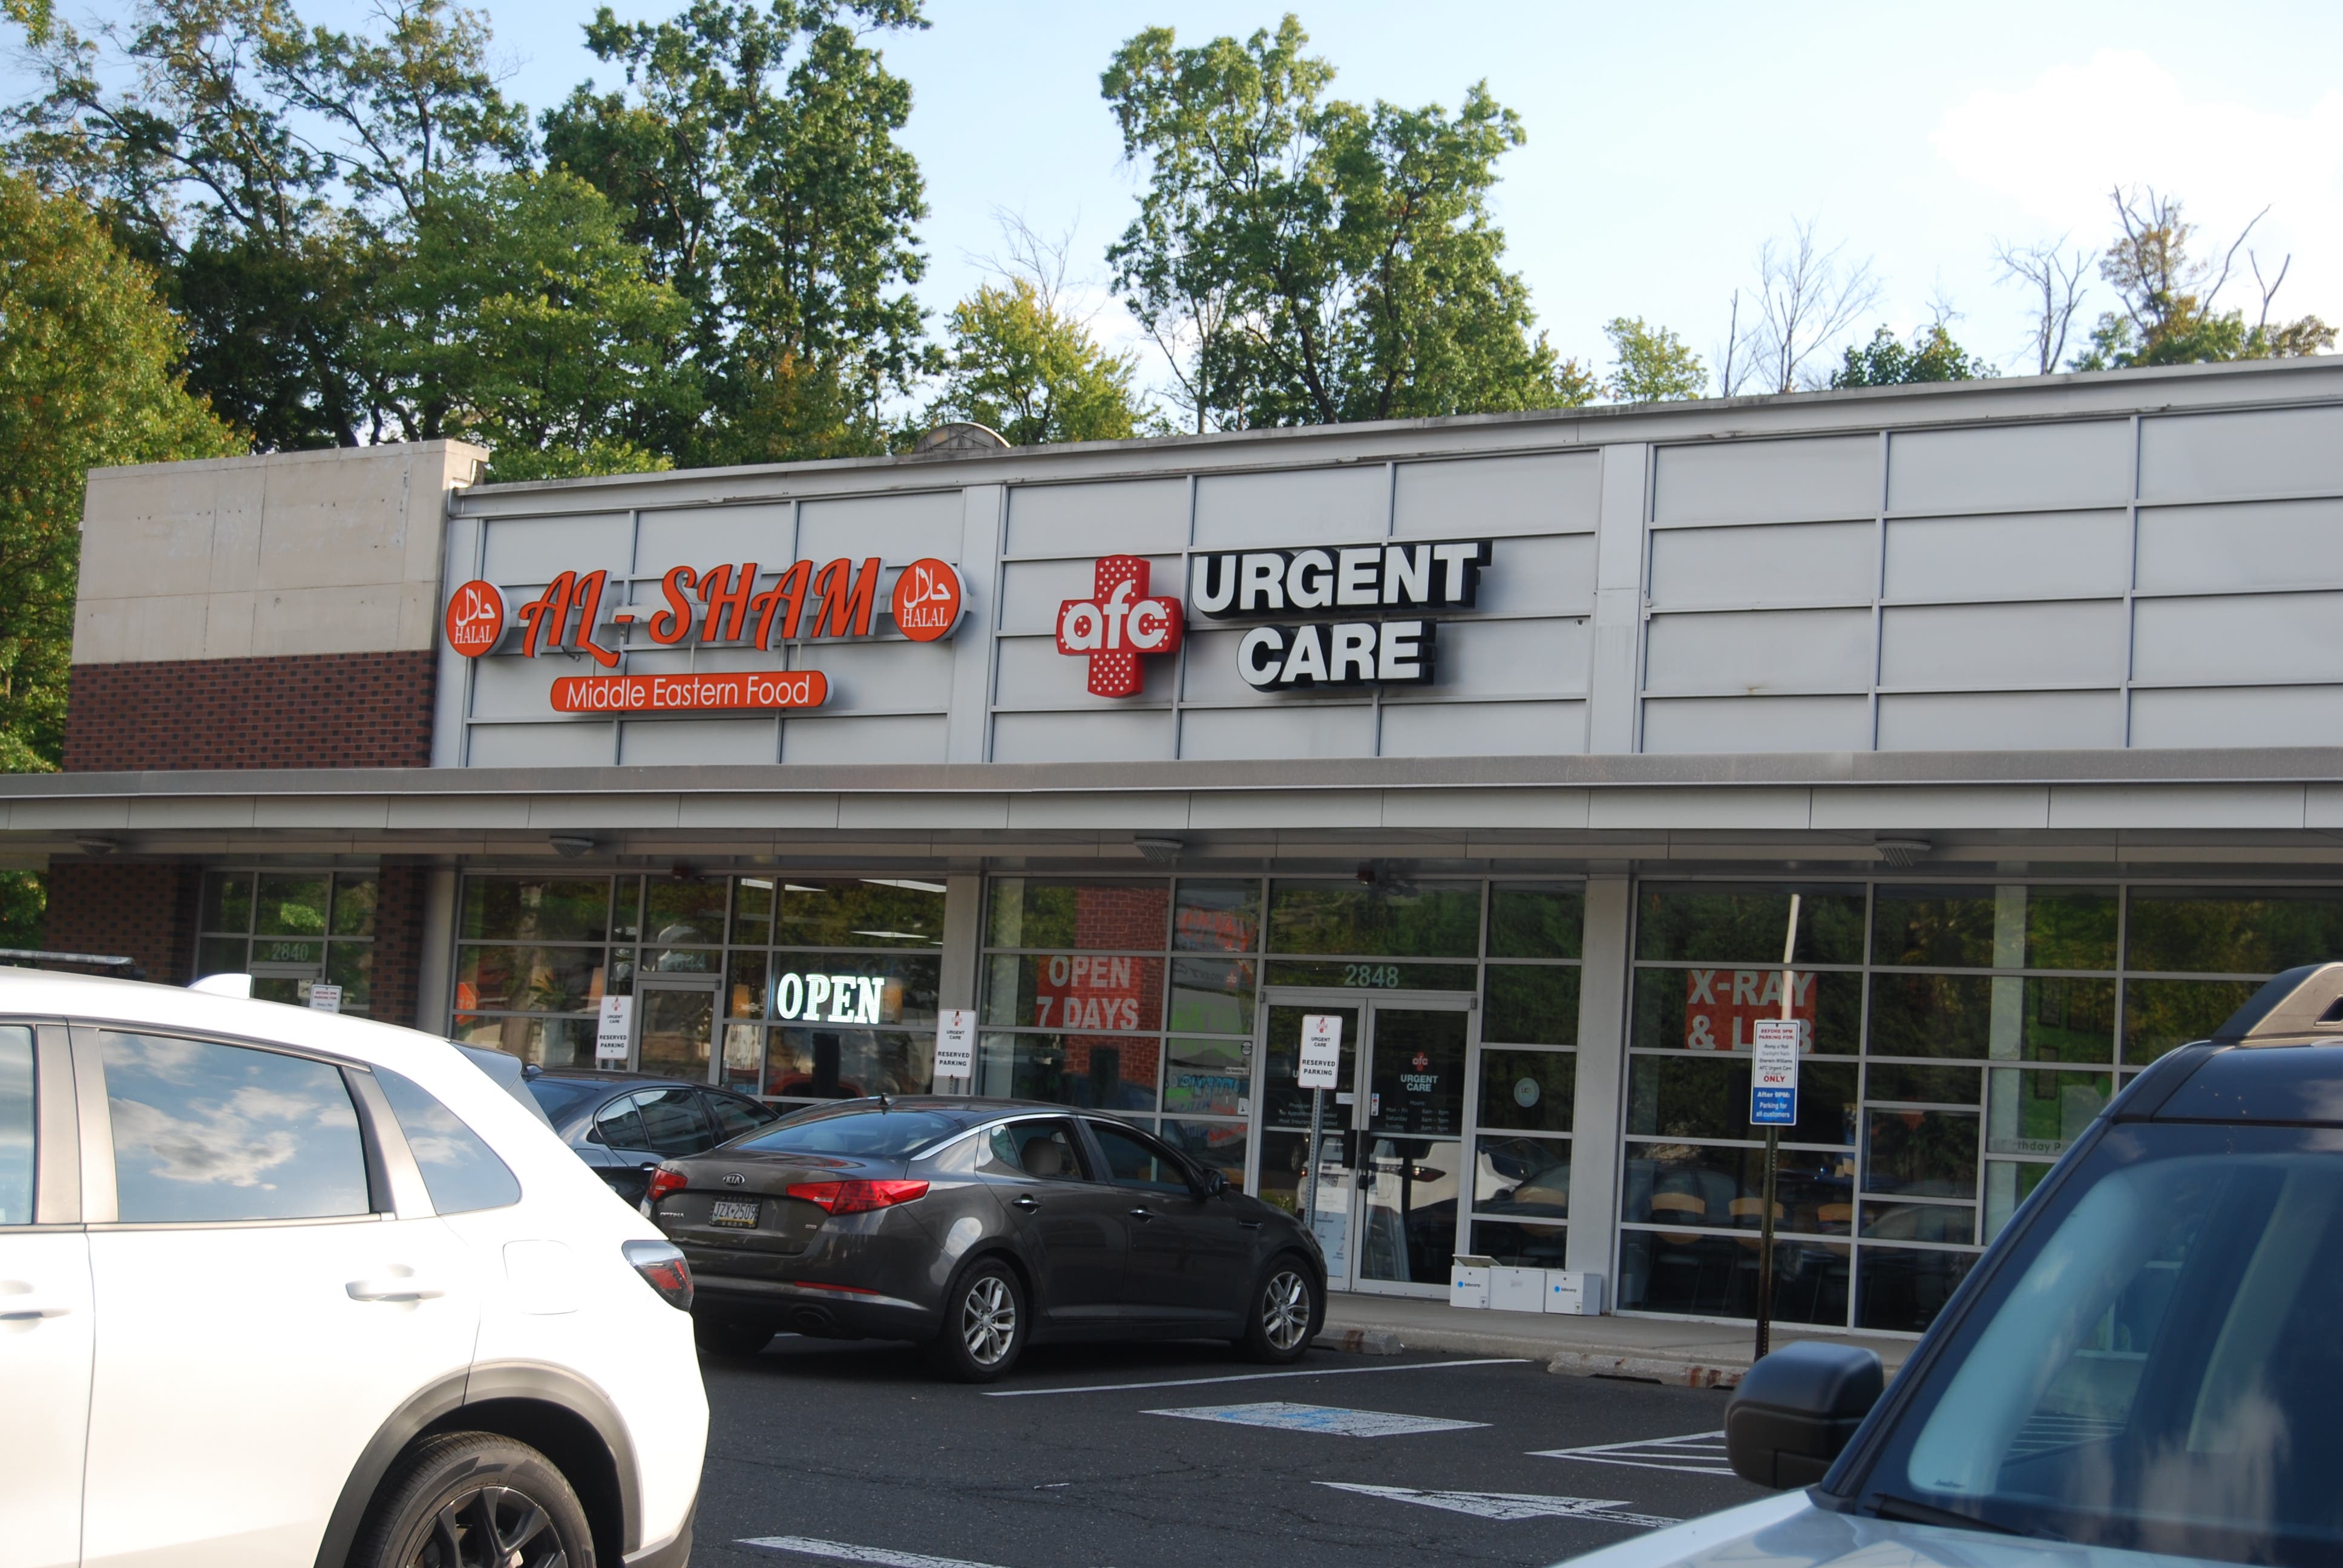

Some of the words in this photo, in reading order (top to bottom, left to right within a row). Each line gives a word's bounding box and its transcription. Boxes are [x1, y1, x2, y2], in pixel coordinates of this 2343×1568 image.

[1191, 543, 1480, 613] URGENT
[902, 607, 948, 628] HALAL
[1062, 580, 1167, 652] afc
[454, 625, 493, 644] HALAL
[1236, 621, 1423, 687] CARE
[566, 679, 646, 709] Middle
[653, 677, 739, 707] Eastern
[746, 674, 810, 705] Food
[271, 942, 309, 961] 2840
[1049, 955, 1131, 988] OPEN
[1343, 964, 1399, 988] 2848
[777, 972, 885, 1025] OPEN
[1688, 969, 1815, 1007] X-RAY
[1036, 996, 1054, 1027] 7
[1063, 997, 1139, 1030] DAYS
[1688, 1015, 1717, 1050] &
[1732, 1016, 1812, 1054] LB
[1412, 1055, 1429, 1065] afc
[1400, 1074, 1439, 1084] URGENT
[1406, 1083, 1432, 1093] CARE
[1759, 1102, 1779, 1111] Parking
[726, 1175, 741, 1184] KIA
